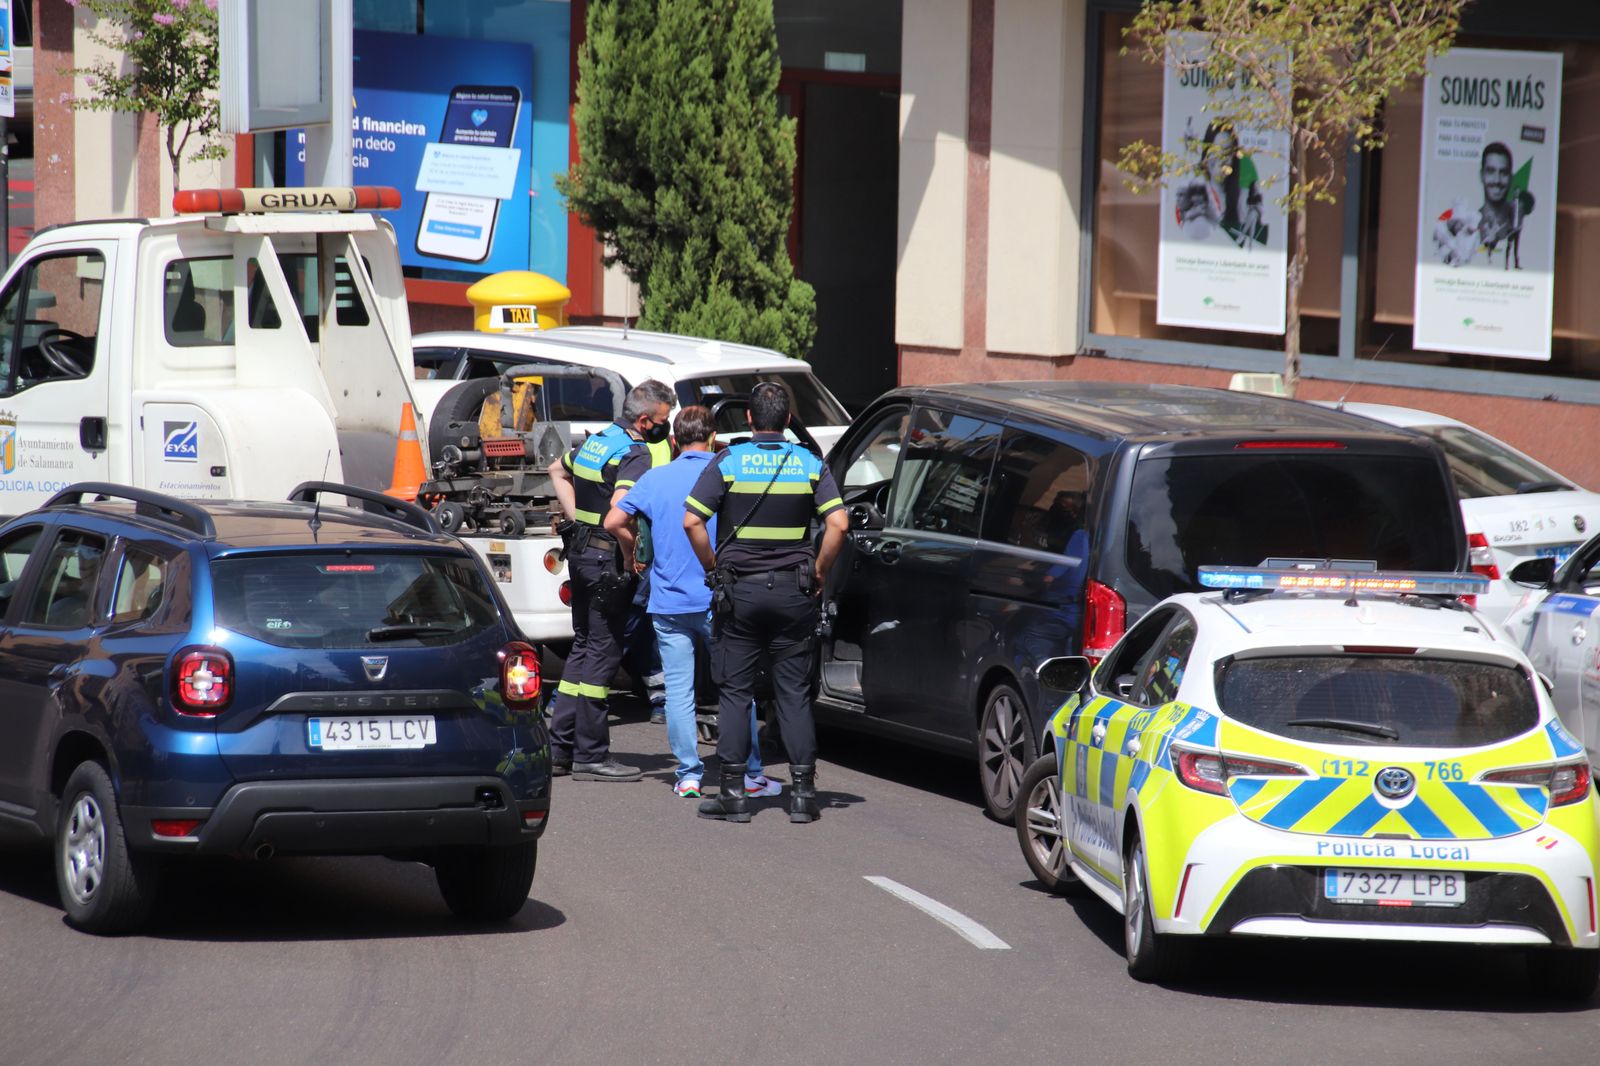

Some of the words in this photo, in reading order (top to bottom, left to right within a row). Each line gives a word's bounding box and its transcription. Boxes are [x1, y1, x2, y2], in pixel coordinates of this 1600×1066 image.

[1440, 76, 1501, 107] SOMOS
[1506, 73, 1545, 110] MÁS
[363, 117, 425, 136] financiera
[366, 135, 396, 152] dedo
[260, 193, 337, 208] GRUA
[511, 308, 531, 323] TAXI
[18, 436, 74, 451] Ayuntamiento
[166, 443, 196, 453] EYSA
[30, 455, 74, 469] Salamanca
[742, 453, 803, 467] POLICIA
[742, 466, 804, 475] SALAMANCA
[326, 720, 382, 741] 4315
[389, 719, 429, 741] LCV
[1424, 761, 1464, 781] 766
[1410, 845, 1470, 861] Local
[1342, 872, 1403, 894] 7327
[1413, 874, 1458, 896] LPB
